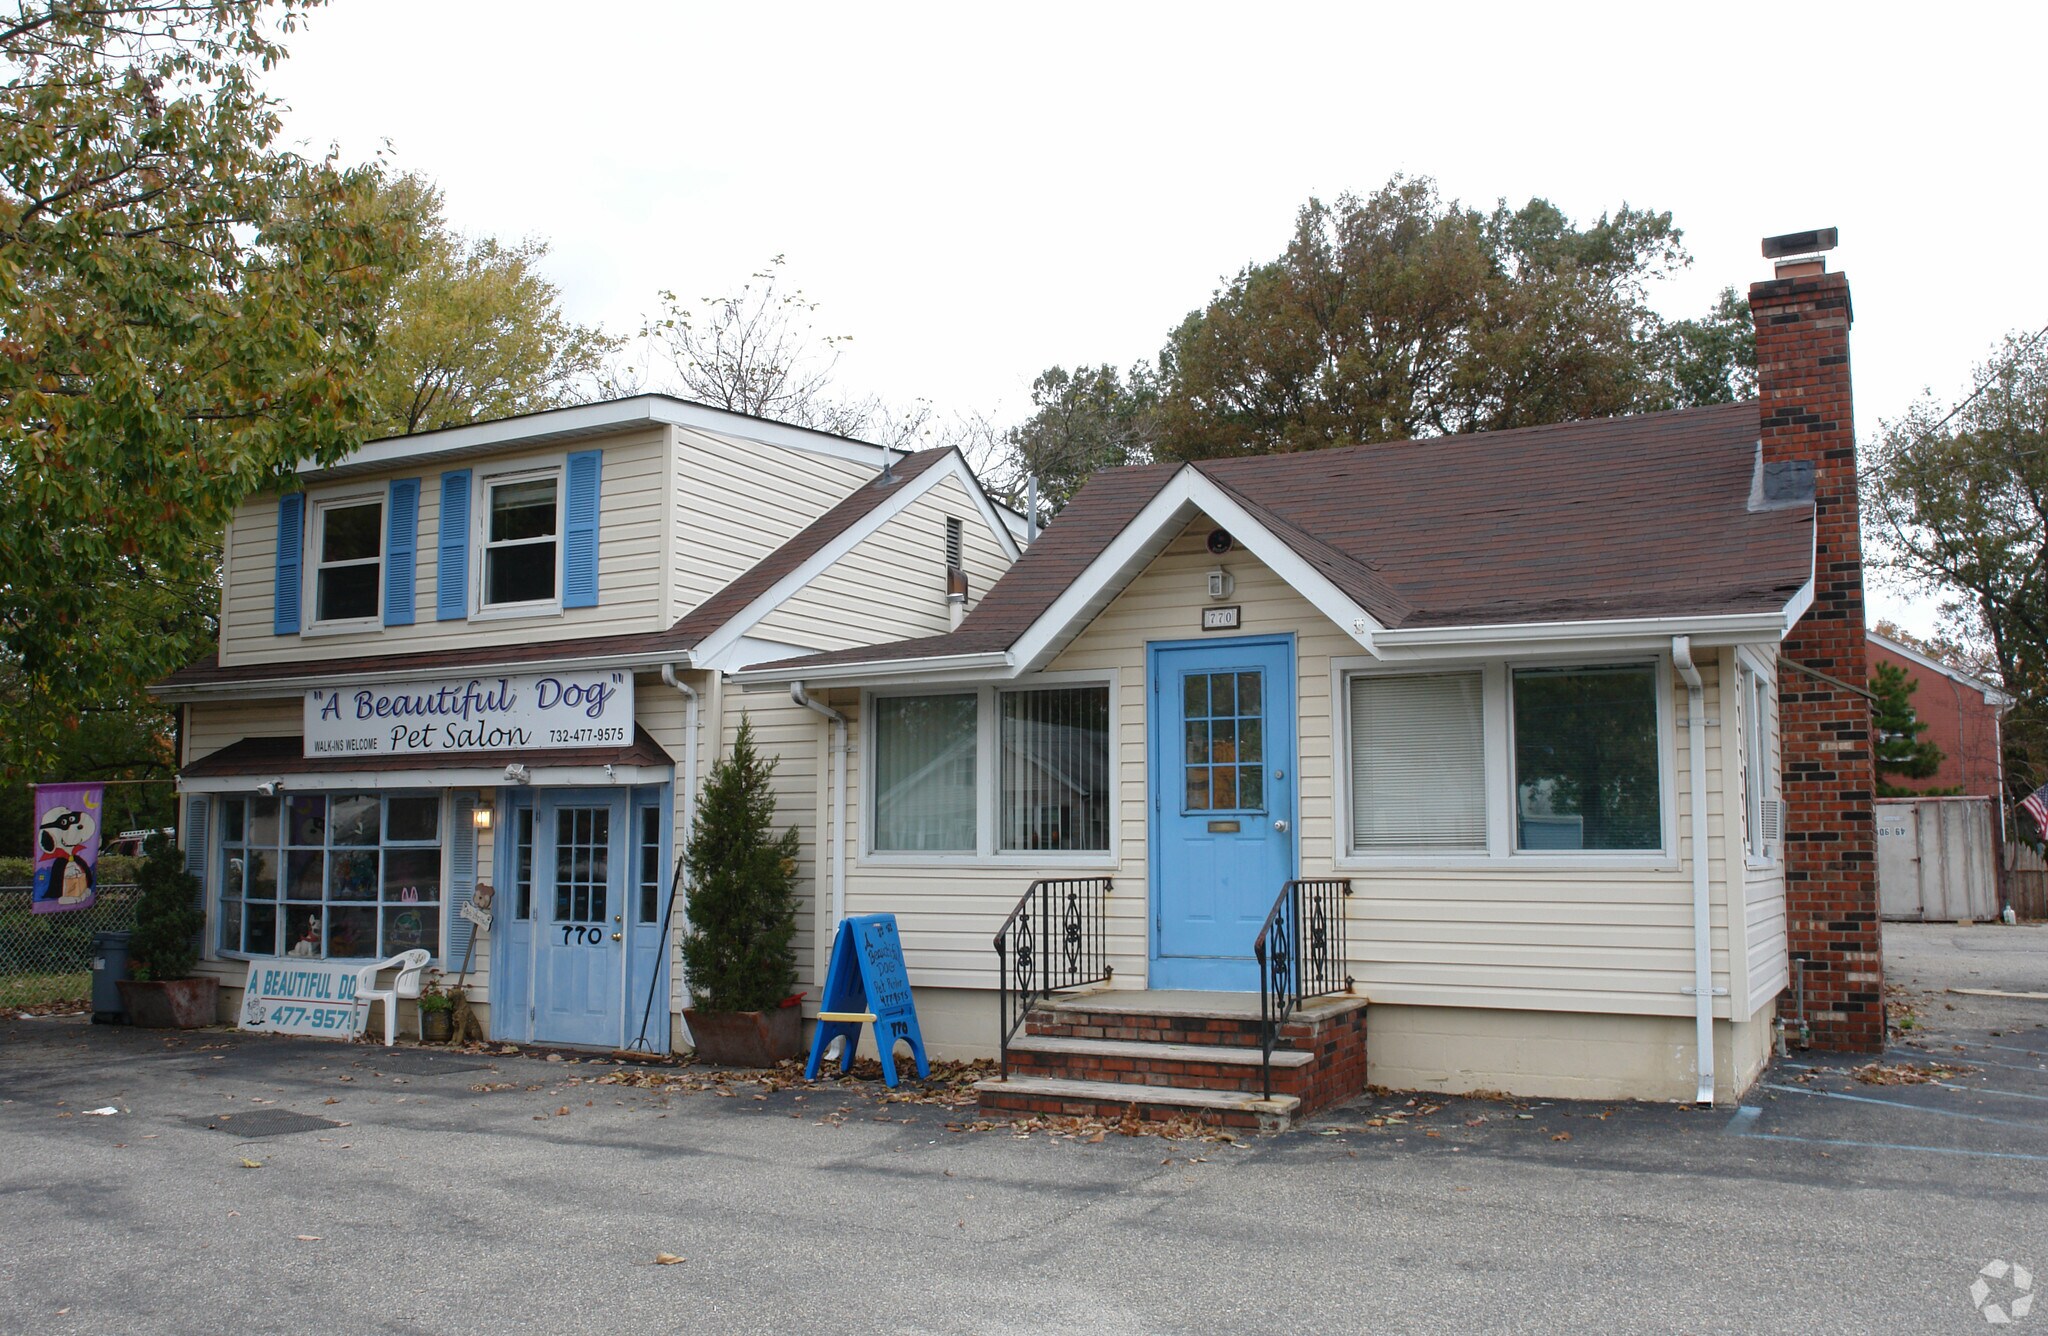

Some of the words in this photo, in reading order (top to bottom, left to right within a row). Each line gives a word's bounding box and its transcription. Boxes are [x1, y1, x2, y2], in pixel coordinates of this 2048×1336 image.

[1210, 612, 1232, 623] 770
[313, 690, 342, 721] "A
[354, 678, 517, 721] Beautiful
[535, 672, 625, 719] Dog"
[390, 723, 437, 751] Pet
[442, 719, 532, 749] Salon
[549, 727, 625, 744] 732-477-9575
[314, 739, 344, 752] WALK-INS
[346, 737, 378, 751] WELCOME
[562, 925, 602, 945] 770
[248, 969, 258, 995] A
[263, 970, 332, 999] BEAUTIFUL
[891, 1021, 908, 1038] 770
